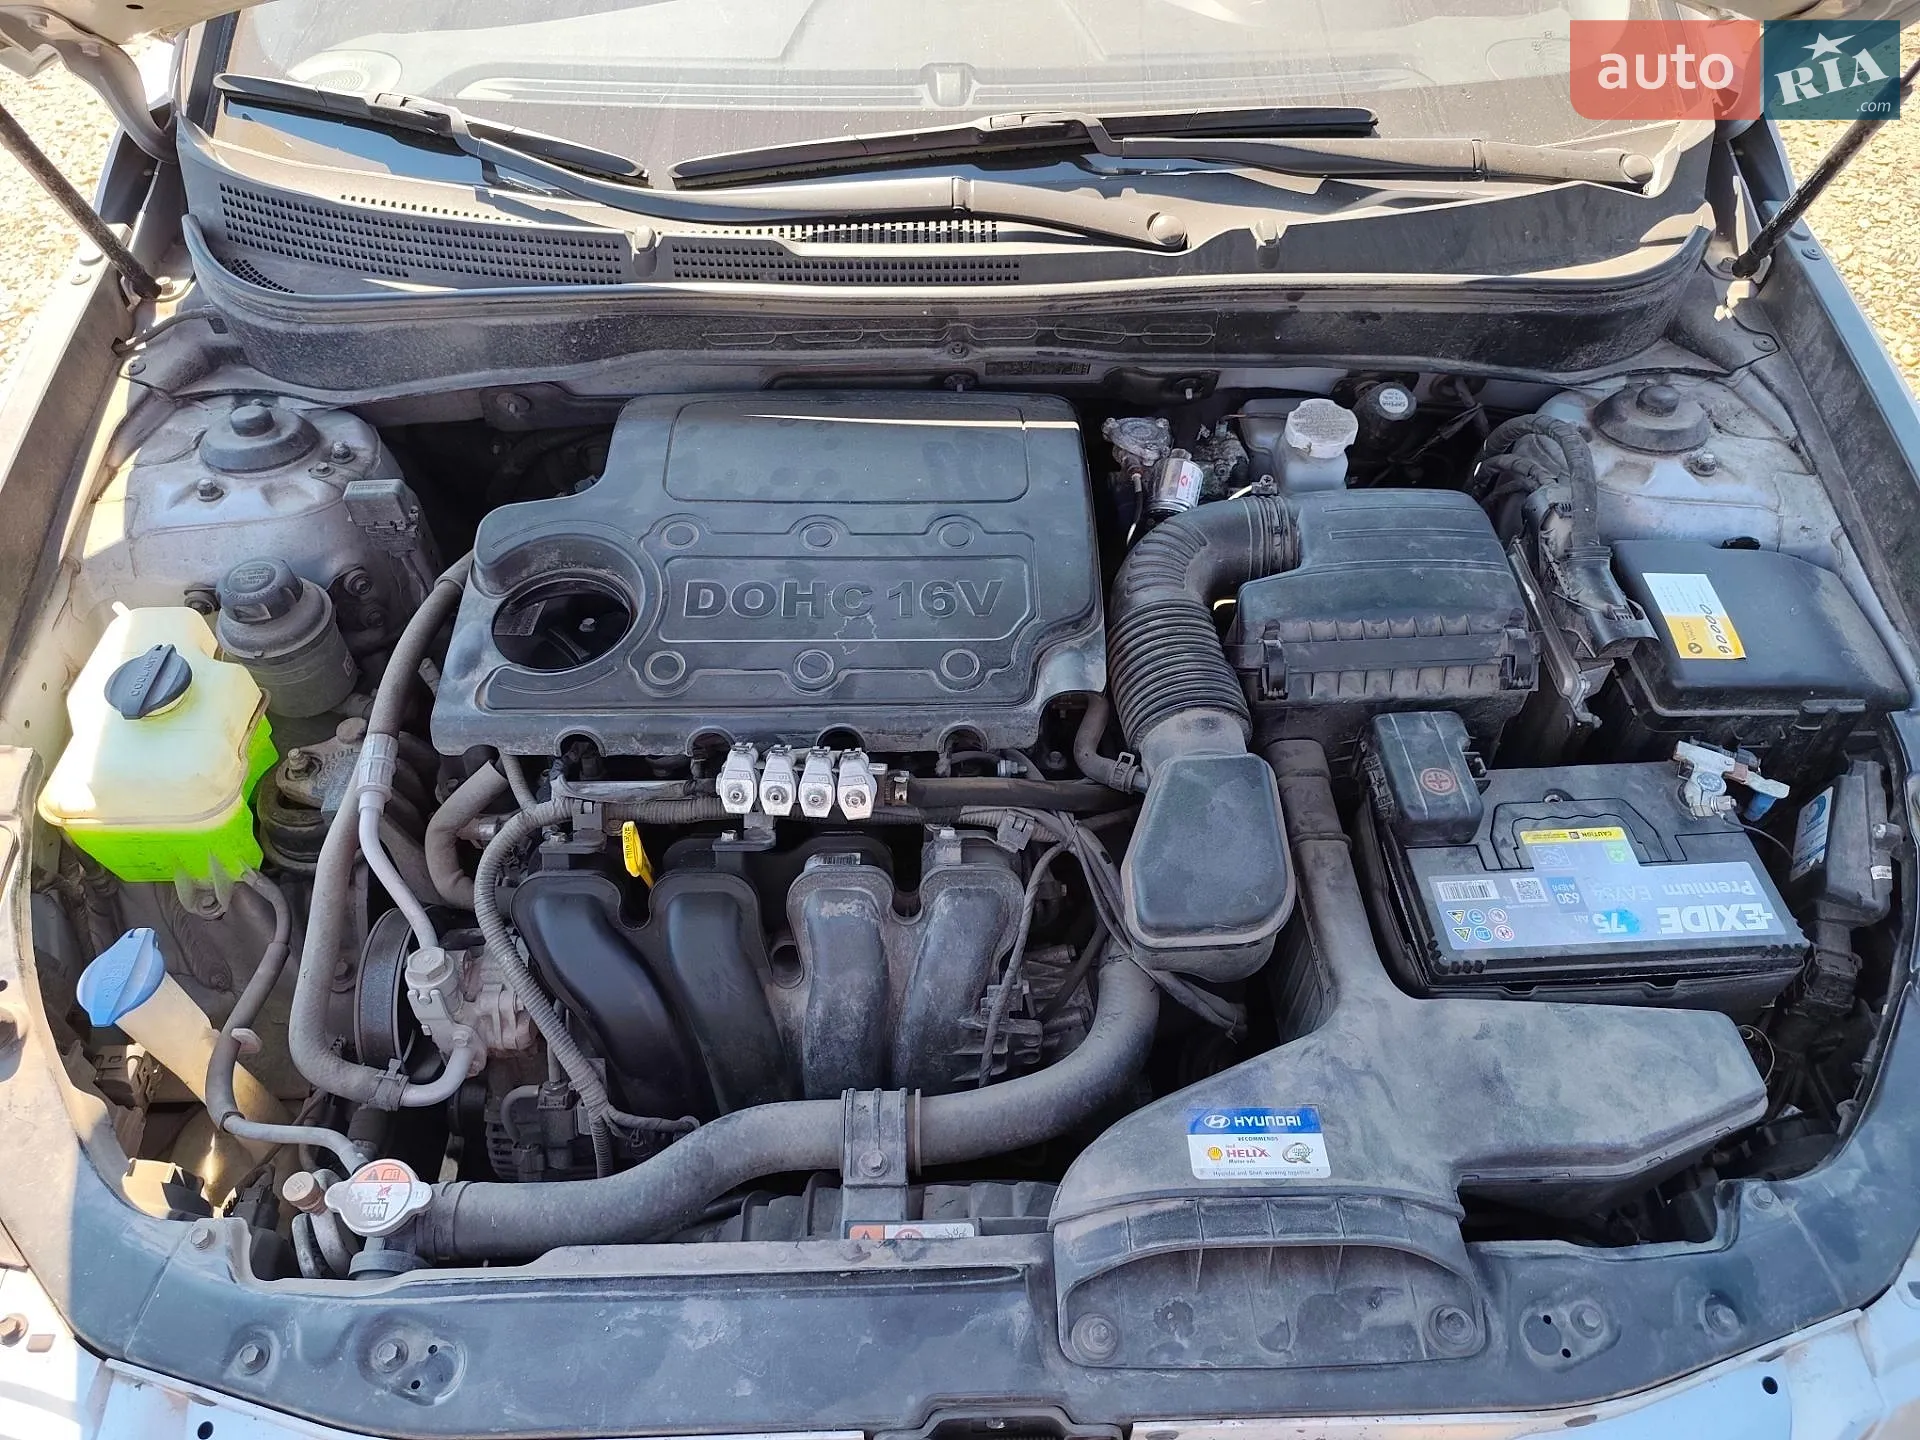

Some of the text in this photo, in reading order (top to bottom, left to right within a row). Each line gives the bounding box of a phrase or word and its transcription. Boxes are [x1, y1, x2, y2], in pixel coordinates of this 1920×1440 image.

[683, 579, 1004, 618] DOHC 16V
[1580, 830, 1613, 838] CAUTION
[1662, 880, 1757, 898] Premium
[1556, 892, 1580, 904] 630
[1592, 912, 1628, 934] 75
[1656, 902, 1773, 934] EXIDE
[1234, 1115, 1302, 1127] HYUNDAI
[1226, 1148, 1271, 1158] HELIX
